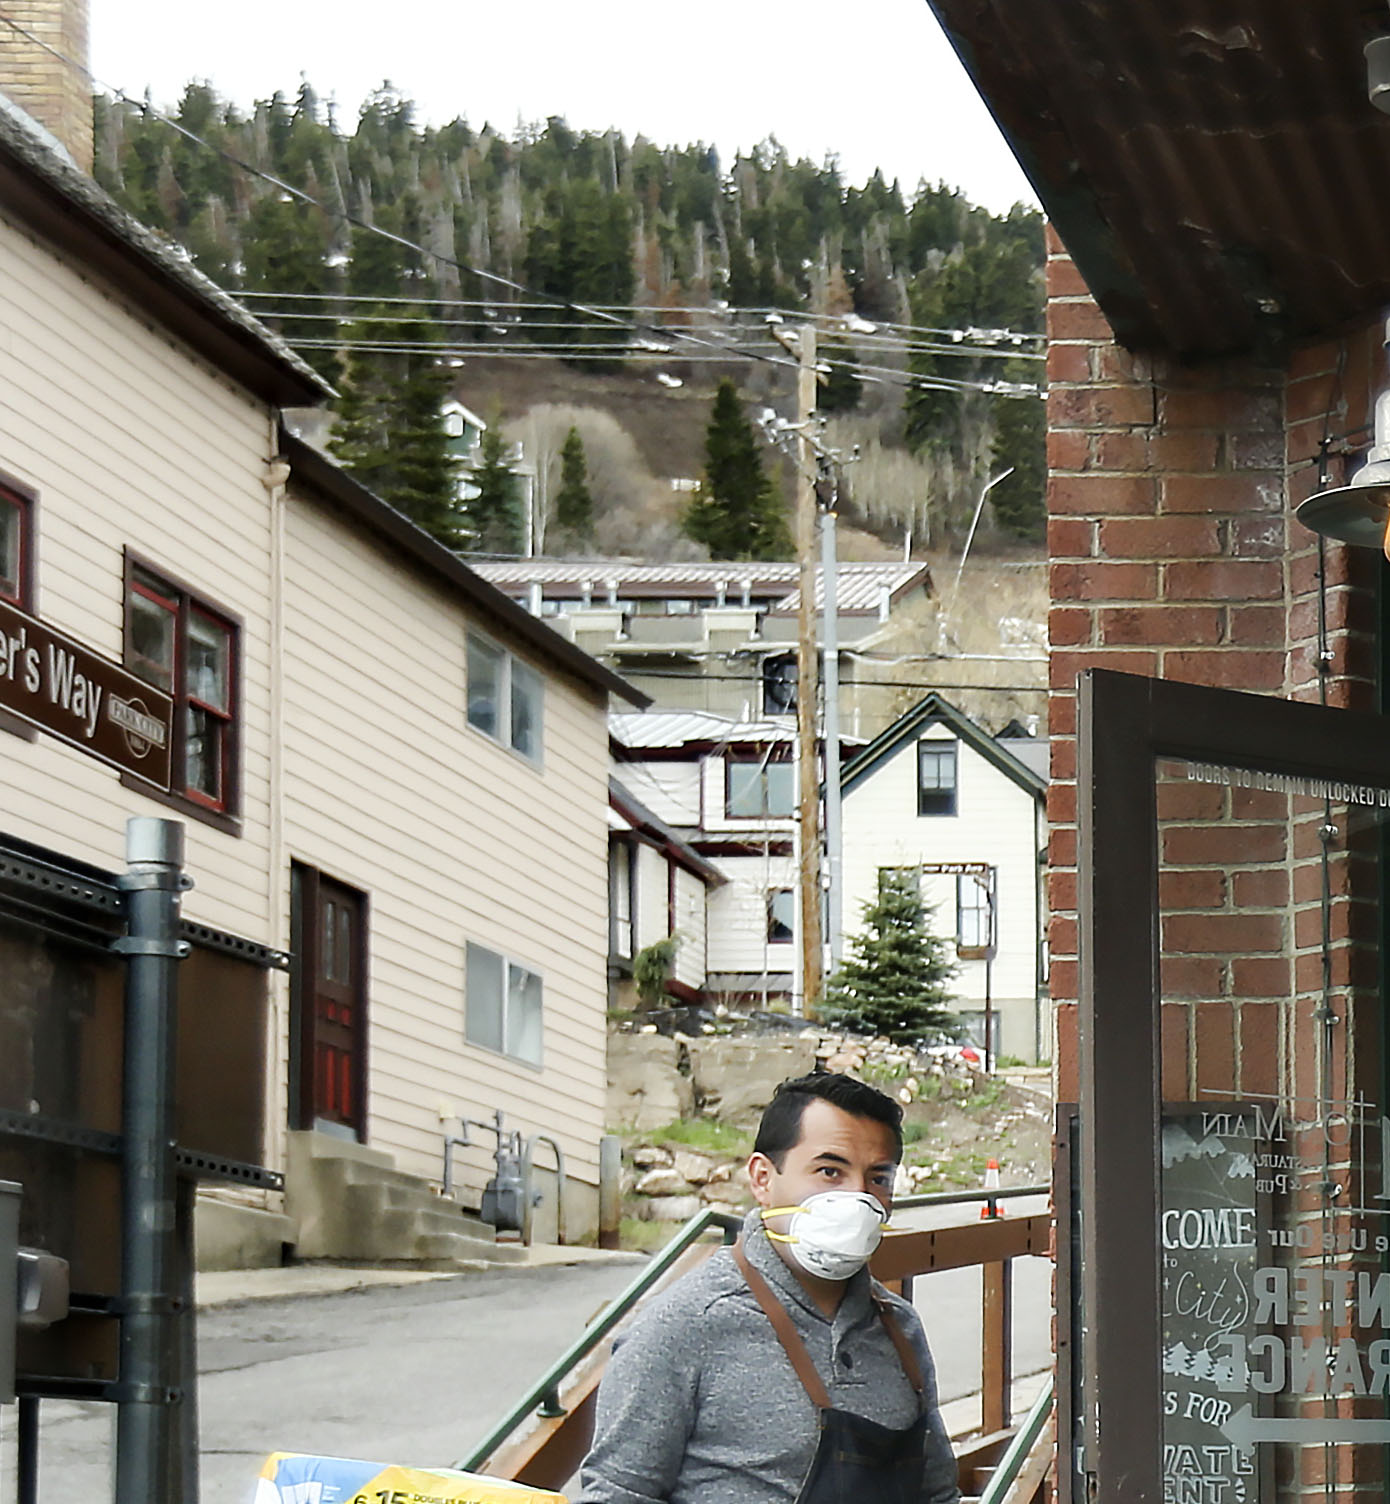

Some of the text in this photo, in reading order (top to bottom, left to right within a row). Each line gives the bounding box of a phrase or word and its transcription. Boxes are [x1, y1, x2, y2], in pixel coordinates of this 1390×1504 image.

[49, 643, 102, 738] Way
[1188, 762, 1229, 785] DOORS
[1236, 768, 1250, 788] TO
[1257, 771, 1305, 796] REMAIN
[1310, 779, 1375, 806] UNLOCKED
[1176, 1261, 1249, 1351] City
[1184, 1391, 1232, 1427] FOR
